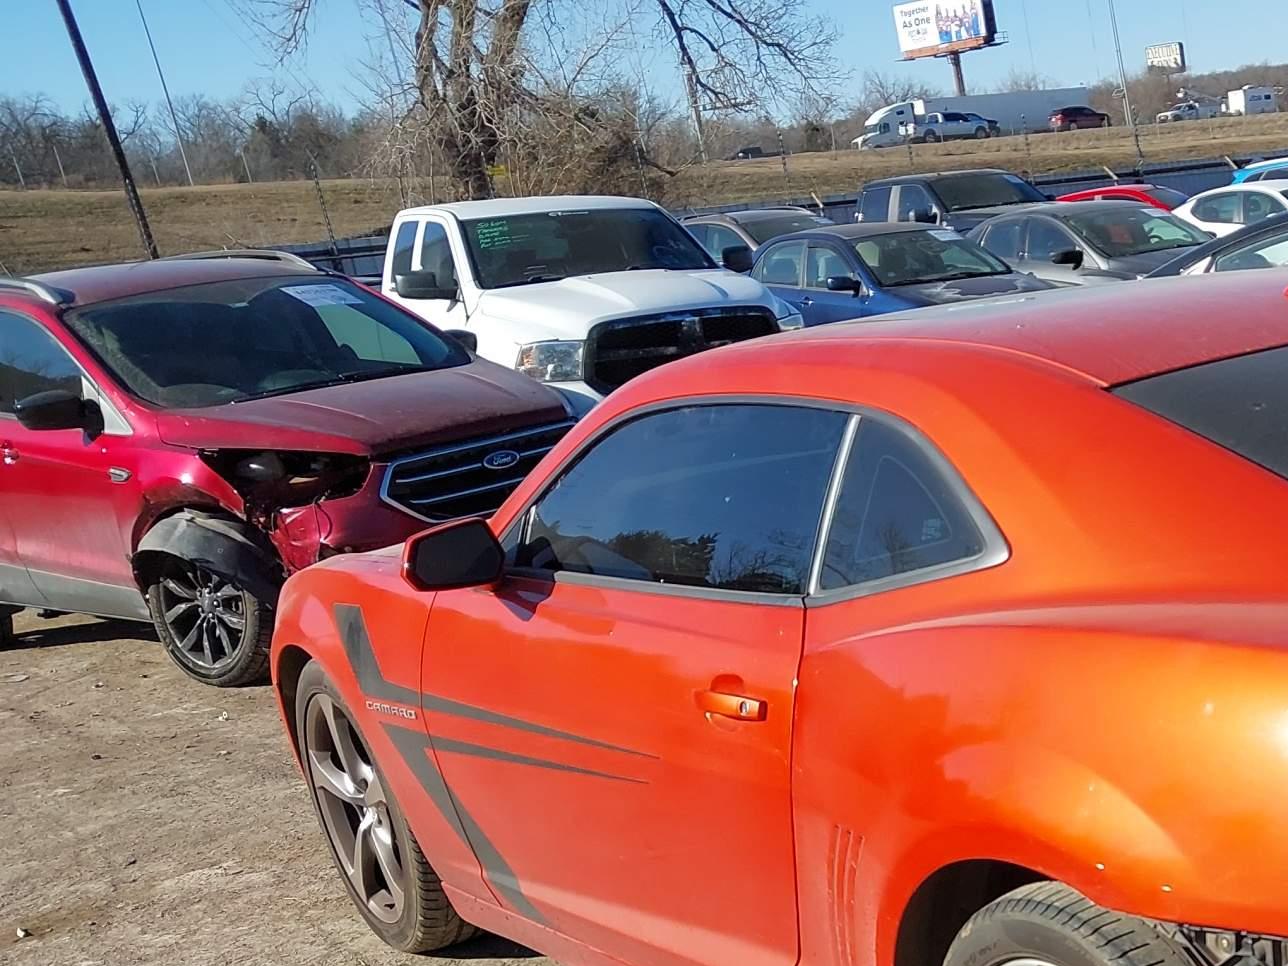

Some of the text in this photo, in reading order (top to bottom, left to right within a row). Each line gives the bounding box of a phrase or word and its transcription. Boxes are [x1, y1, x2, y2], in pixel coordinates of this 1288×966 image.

[900, 6, 929, 18] Together
[903, 17, 931, 29] As One
[366, 701, 416, 719] CAMARO
